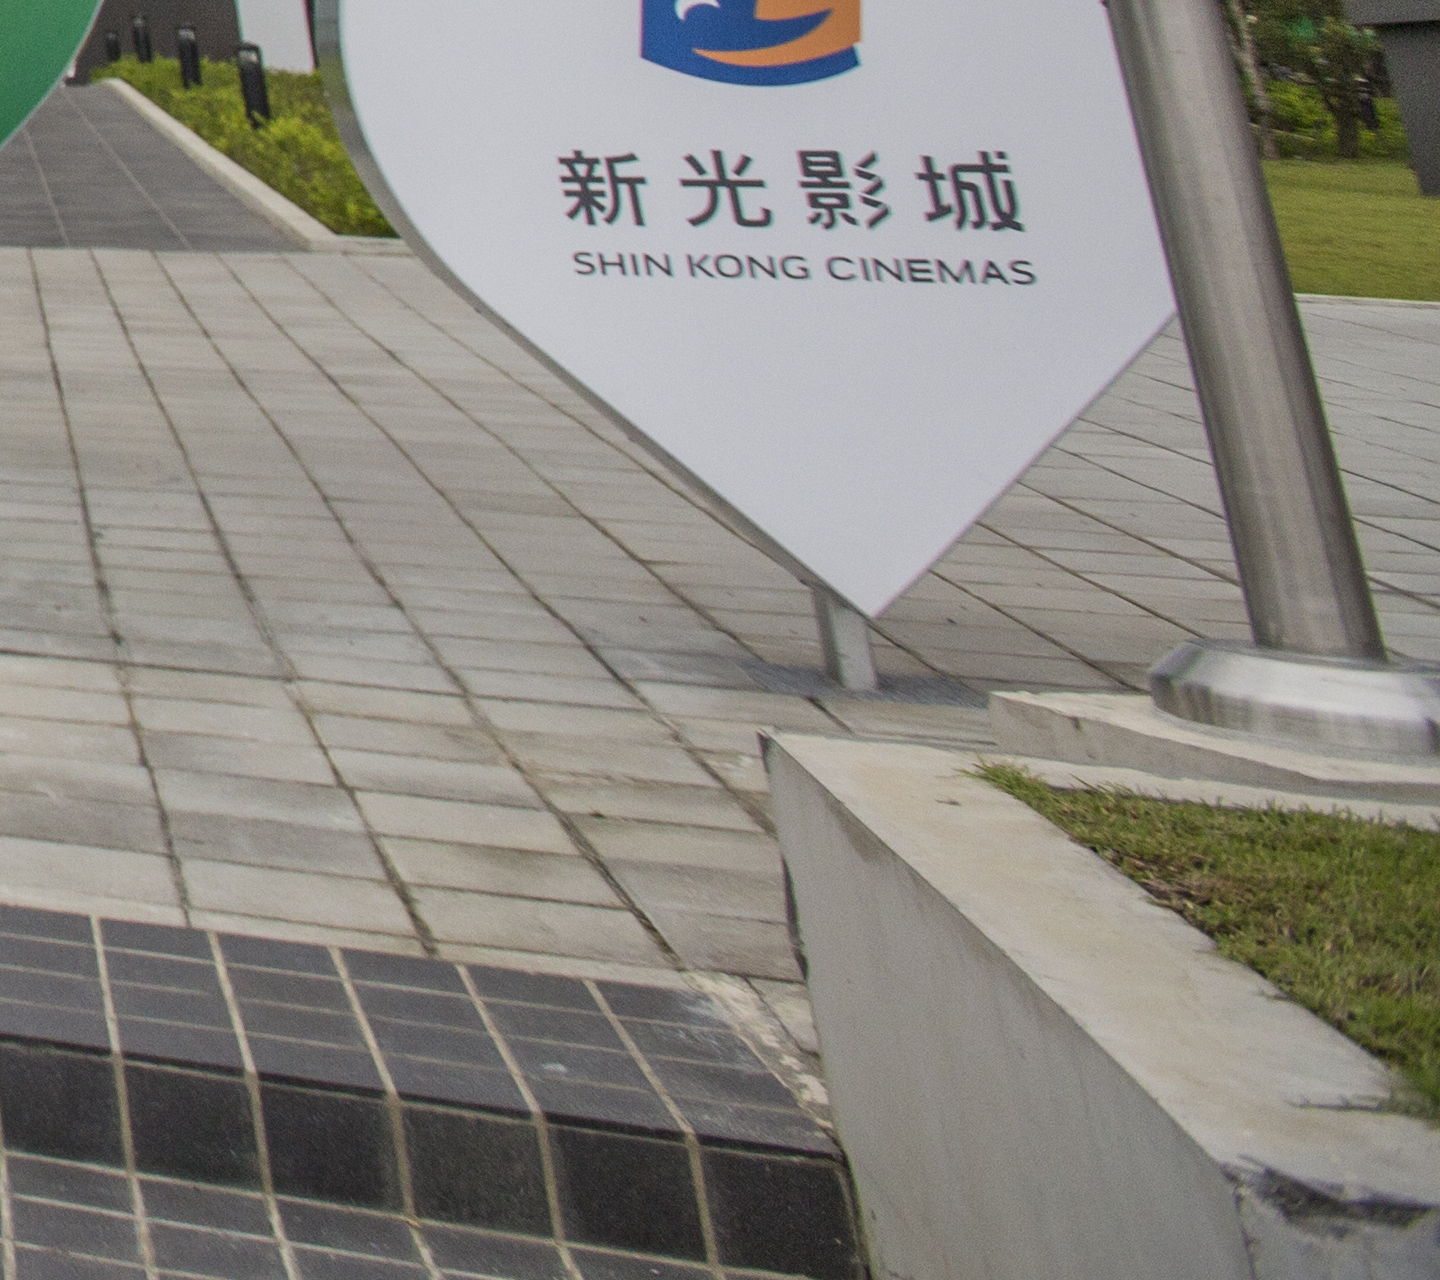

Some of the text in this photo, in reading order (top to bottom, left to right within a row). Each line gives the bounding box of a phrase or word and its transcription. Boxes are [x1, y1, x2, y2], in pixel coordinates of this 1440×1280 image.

[557, 148, 1026, 233] 新光影城
[572, 251, 1039, 286] SHIN KONG CINEMAS
